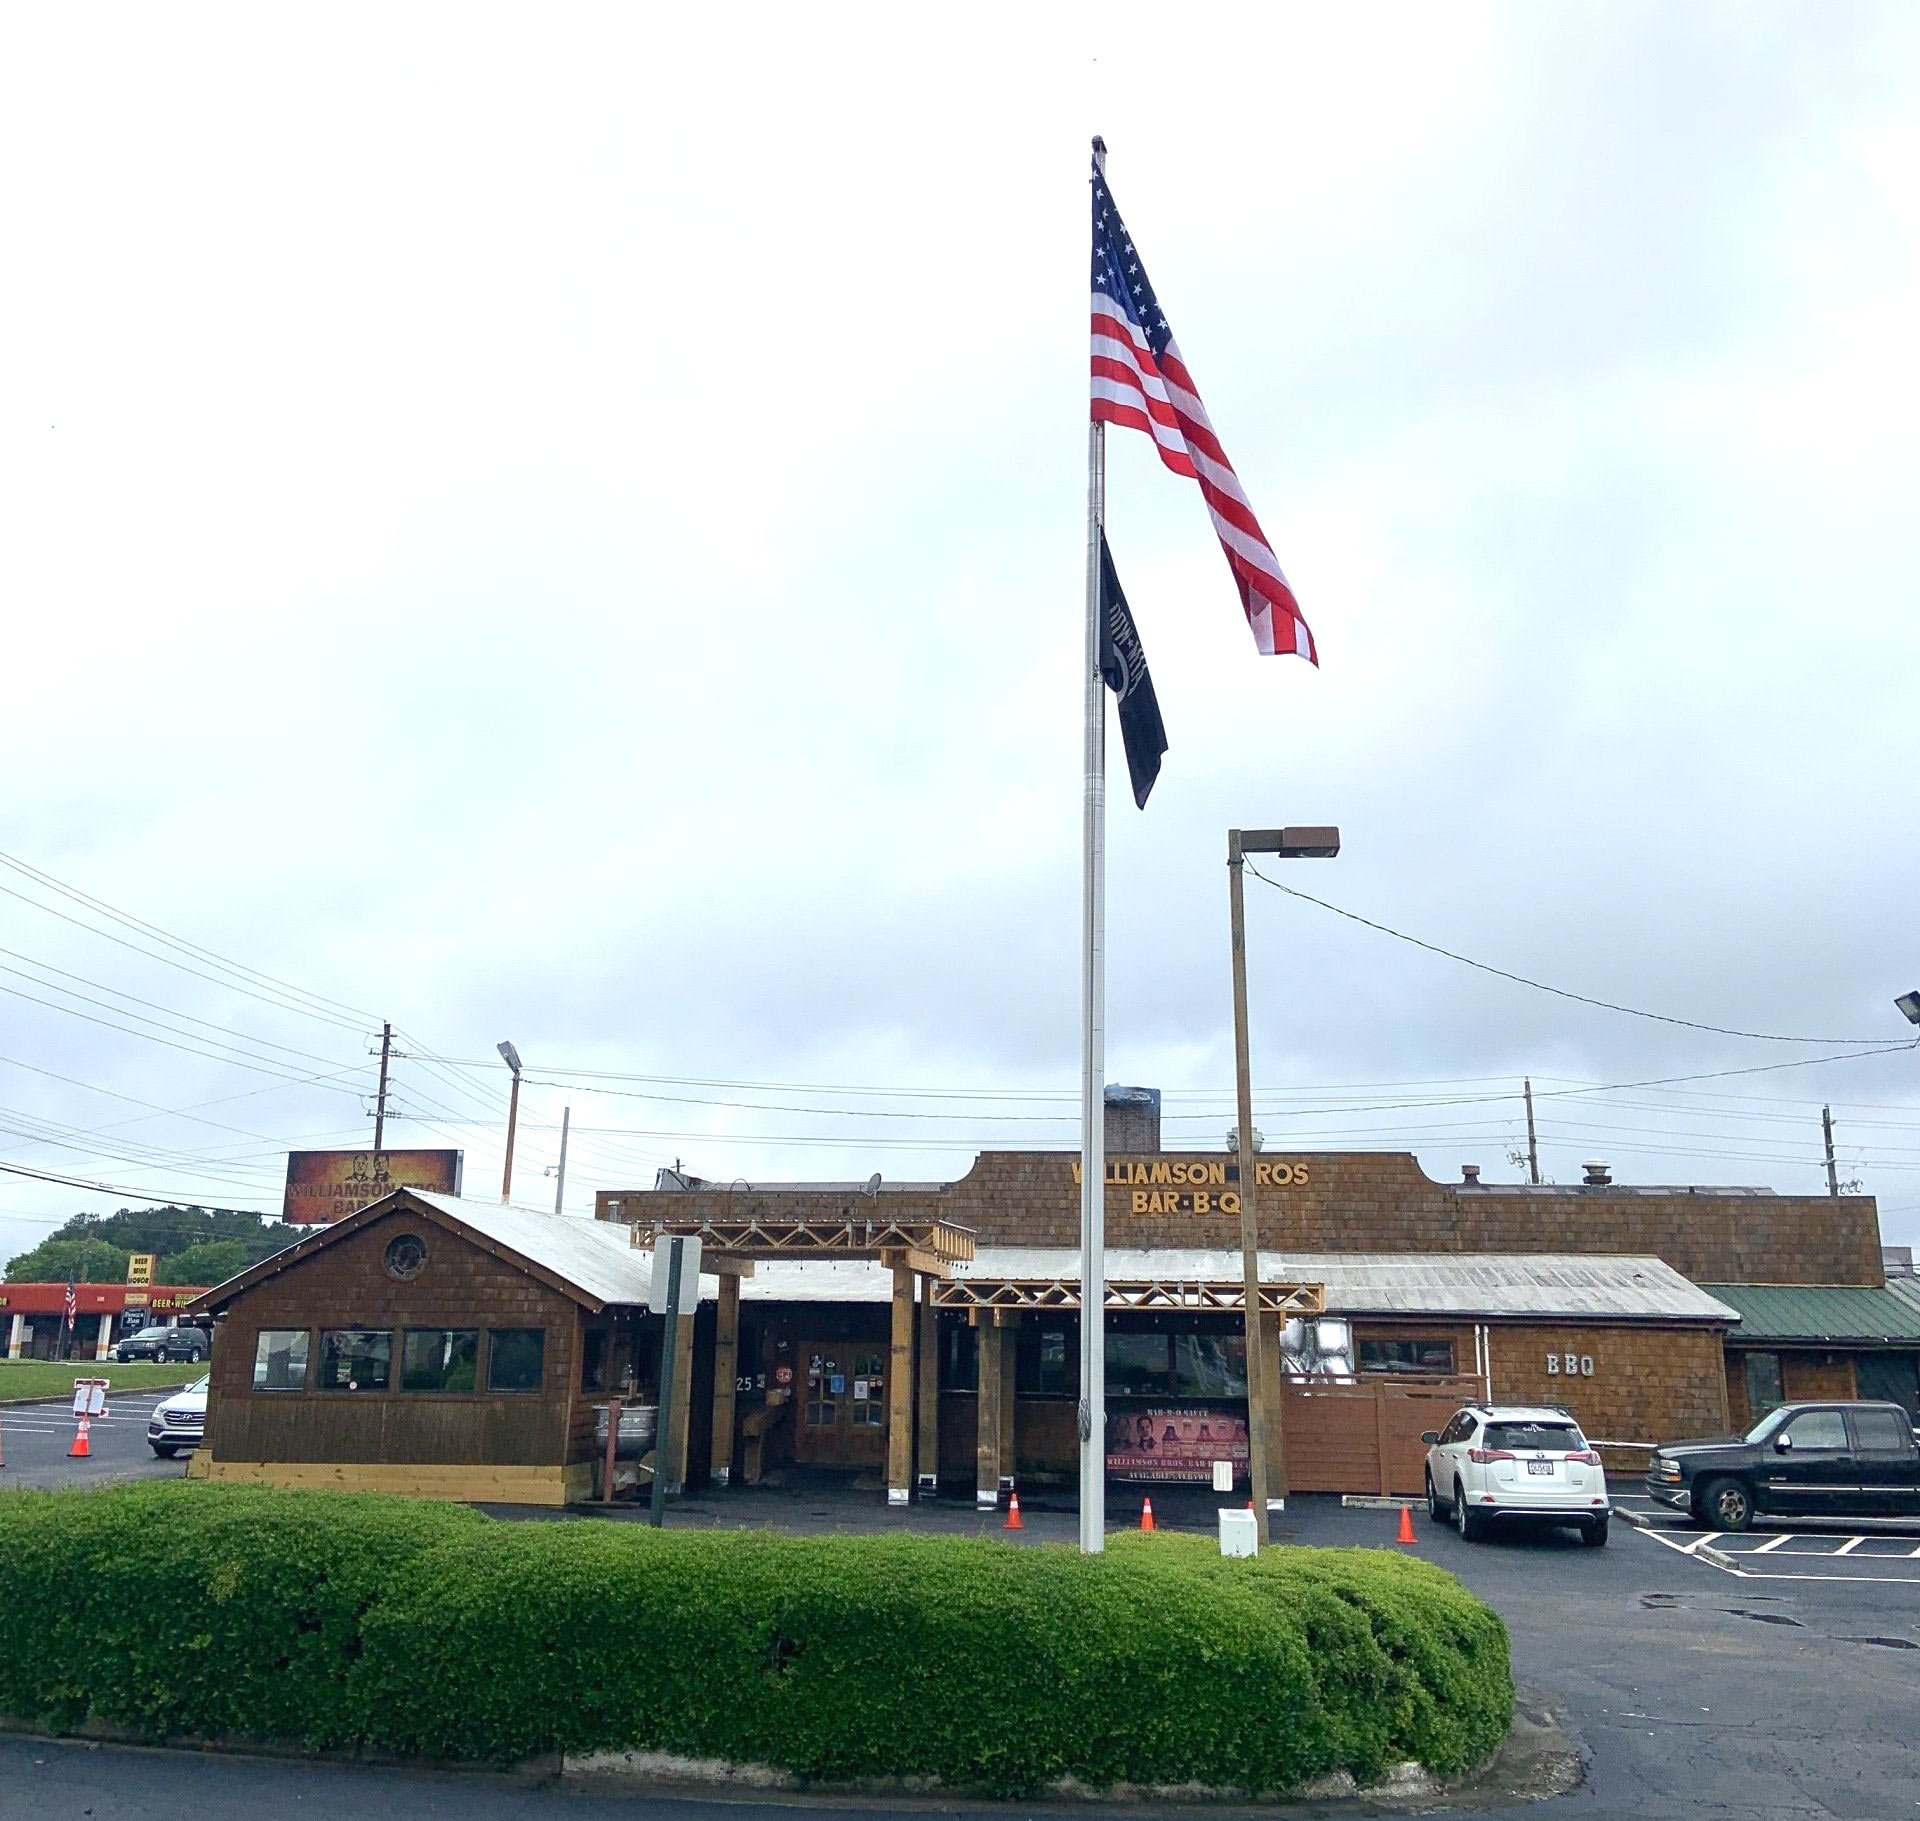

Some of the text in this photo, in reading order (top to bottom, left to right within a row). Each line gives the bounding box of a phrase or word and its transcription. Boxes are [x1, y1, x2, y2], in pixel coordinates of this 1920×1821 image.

[1071, 1161, 1309, 1185] LLIAMSON ROS
[287, 1182, 396, 1199] WILLIAMSON
[1546, 1353, 1596, 1377] BBQ
[1106, 1457, 1159, 1467] WILLIAMSON
